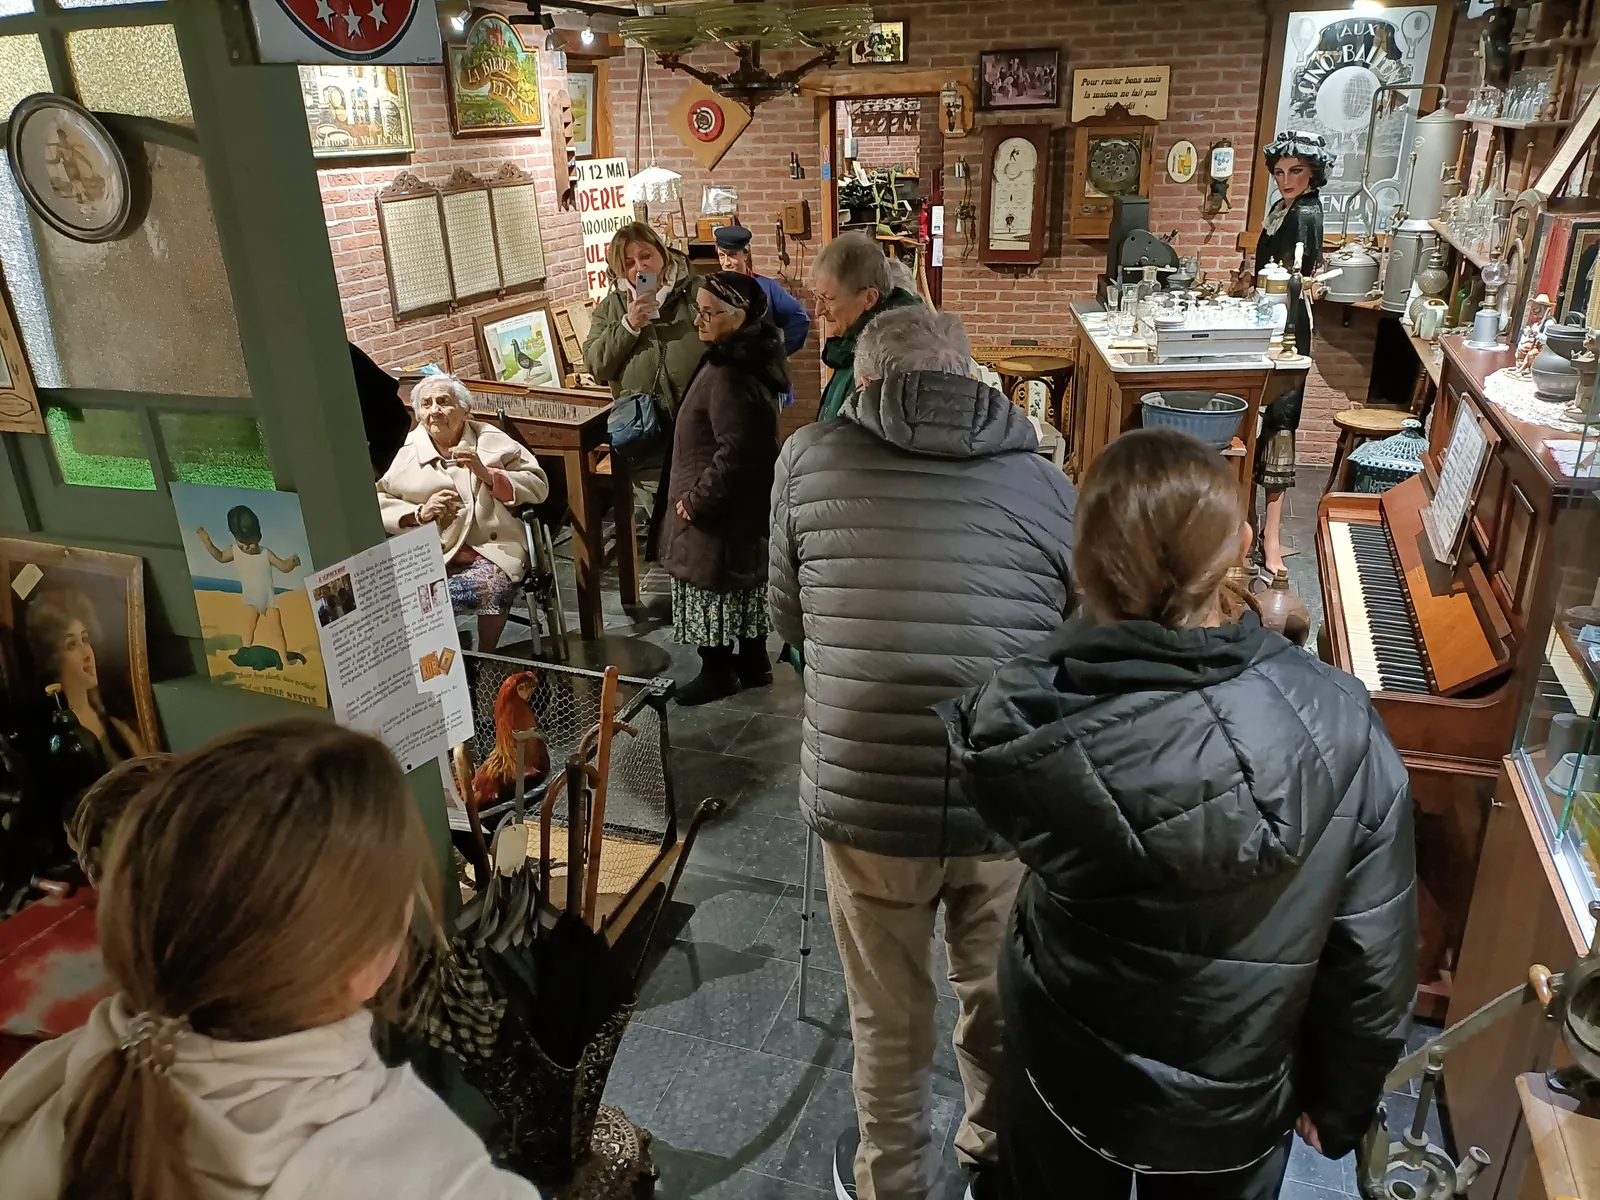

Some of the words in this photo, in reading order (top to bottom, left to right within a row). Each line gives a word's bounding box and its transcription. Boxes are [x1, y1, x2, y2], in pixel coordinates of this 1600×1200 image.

[1340, 23, 1377, 38] AUX
[468, 68, 480, 84] LA
[1081, 78, 1099, 86] Pour
[1125, 76, 1142, 84] bons
[1144, 75, 1162, 83] amis
[1298, 52, 1336, 94] CINQ
[493, 80, 504, 97] ET
[505, 86, 517, 106] LE
[518, 98, 535, 117] VIN
[1083, 90, 1090, 99] la
[1093, 90, 1118, 98] maison
[1144, 90, 1158, 98] pas
[589, 164, 603, 180] 12
[606, 161, 625, 178] MAI
[580, 185, 626, 213] DERIE
